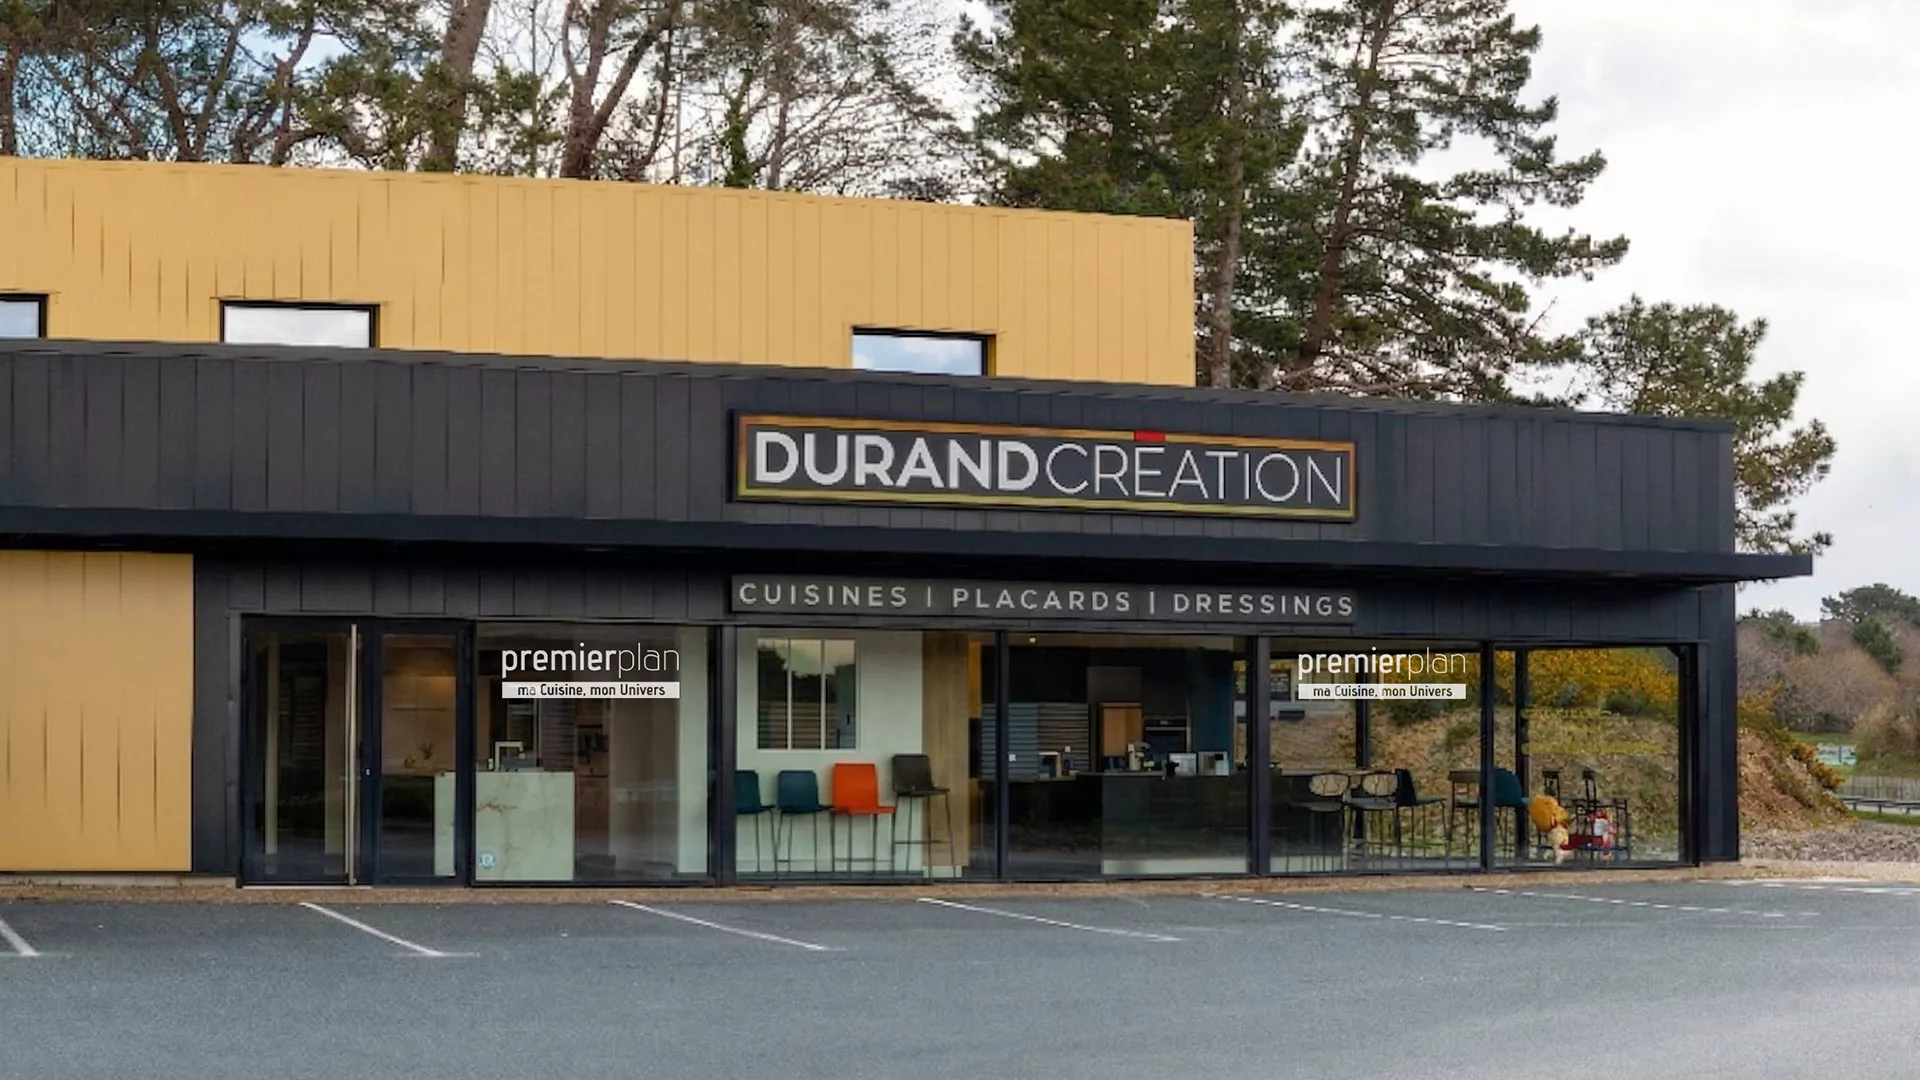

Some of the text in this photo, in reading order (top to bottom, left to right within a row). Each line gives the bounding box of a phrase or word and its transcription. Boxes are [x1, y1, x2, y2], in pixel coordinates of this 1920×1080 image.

[739, 583, 907, 607] CUISINES
[952, 588, 1130, 612] PLACARDS
[1173, 593, 1353, 616] DRESSINGS
[517, 683, 666, 697] ma Cuisine, mon Univers
[1313, 685, 1453, 698] ma Cuisine, mon Univers
